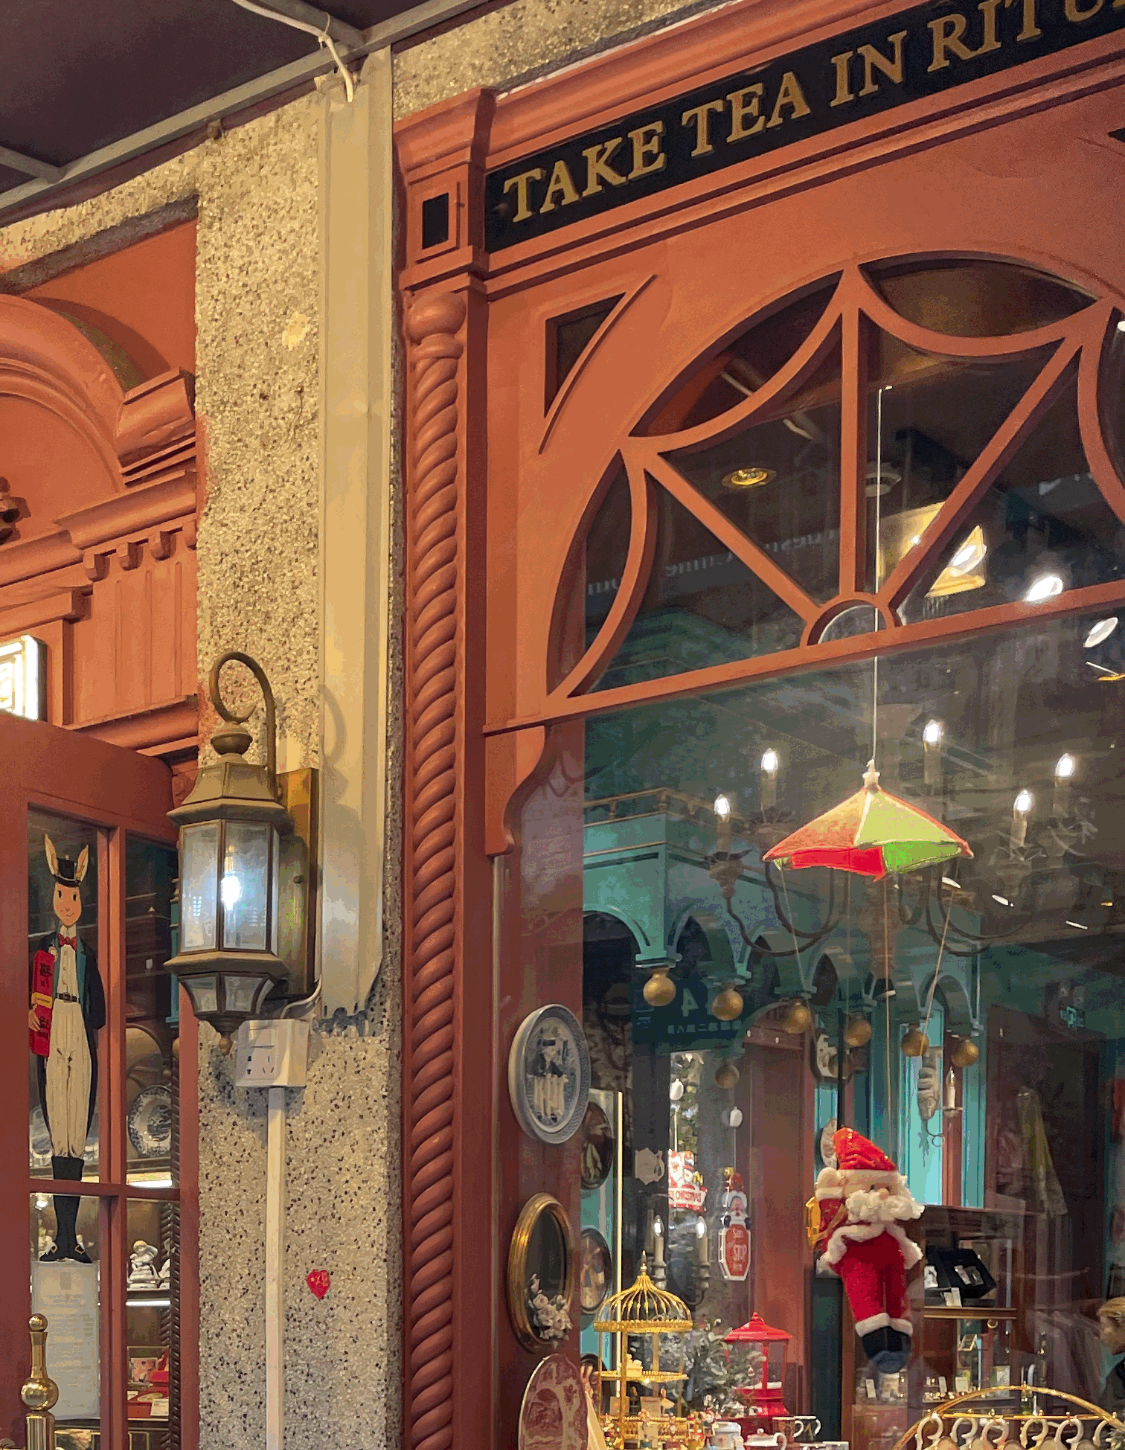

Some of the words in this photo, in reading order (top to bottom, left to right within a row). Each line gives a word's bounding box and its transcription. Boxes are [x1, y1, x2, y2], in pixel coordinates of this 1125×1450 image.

[504, 121, 668, 223] TAKE
[682, 70, 812, 158] TEA
[829, 29, 909, 108] IN
